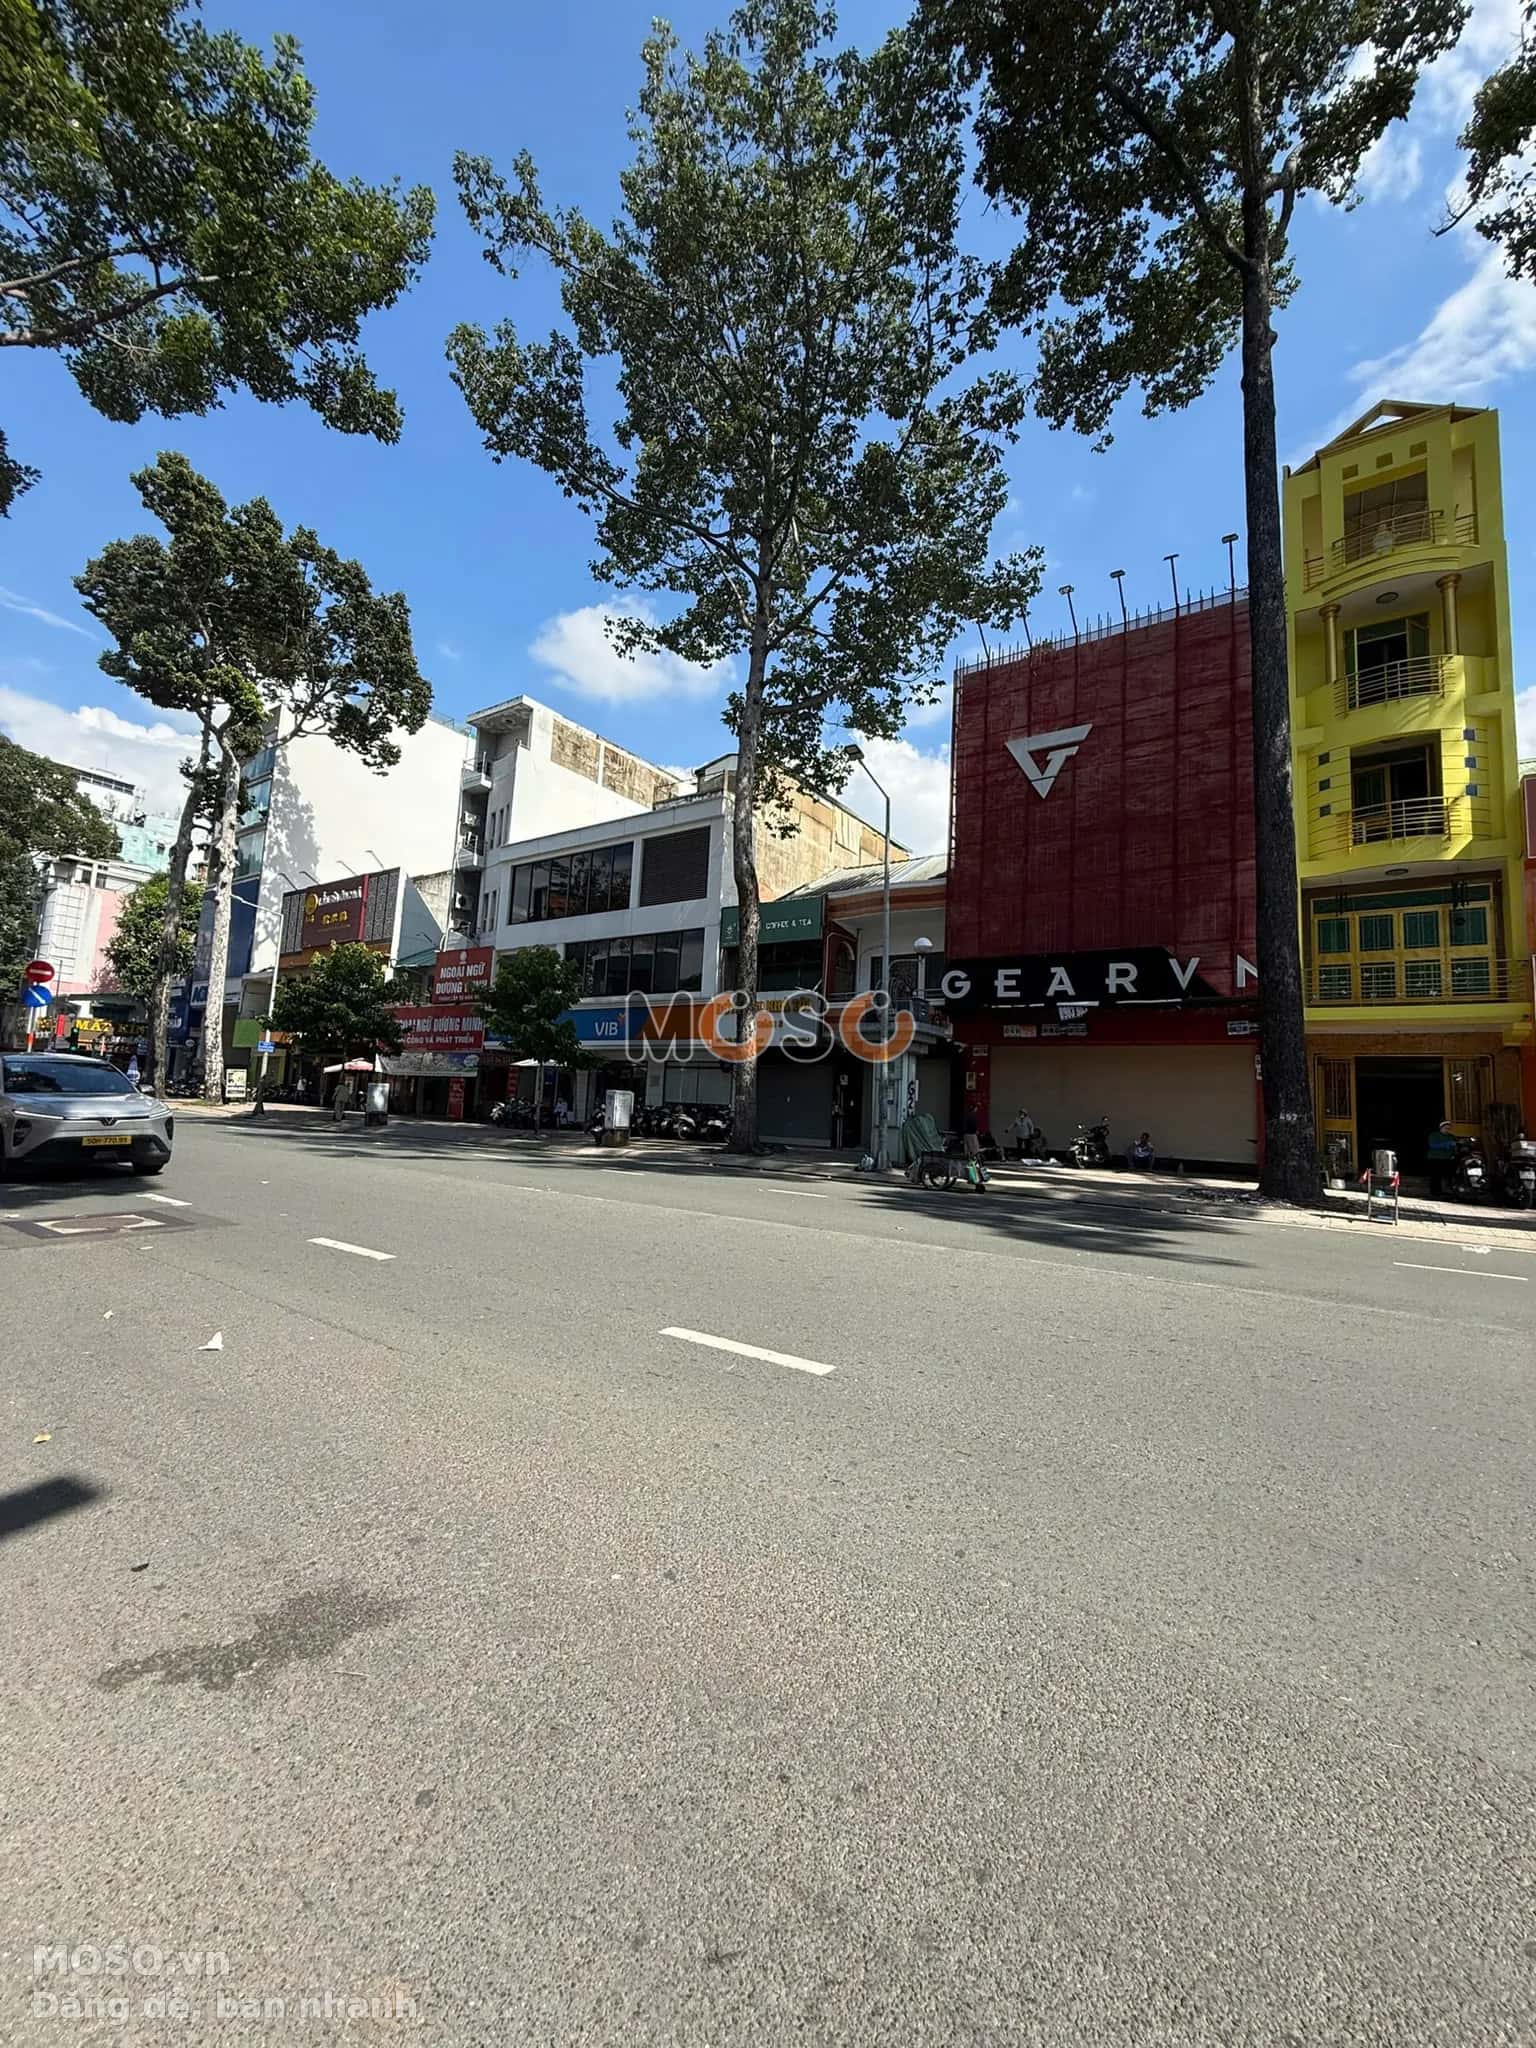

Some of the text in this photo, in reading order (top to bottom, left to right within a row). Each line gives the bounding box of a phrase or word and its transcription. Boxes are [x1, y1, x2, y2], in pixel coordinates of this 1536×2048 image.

[798, 918, 812, 927] TEA
[440, 961, 486, 980] NGOẠI NGỮ
[594, 1021, 618, 1037] VIB
